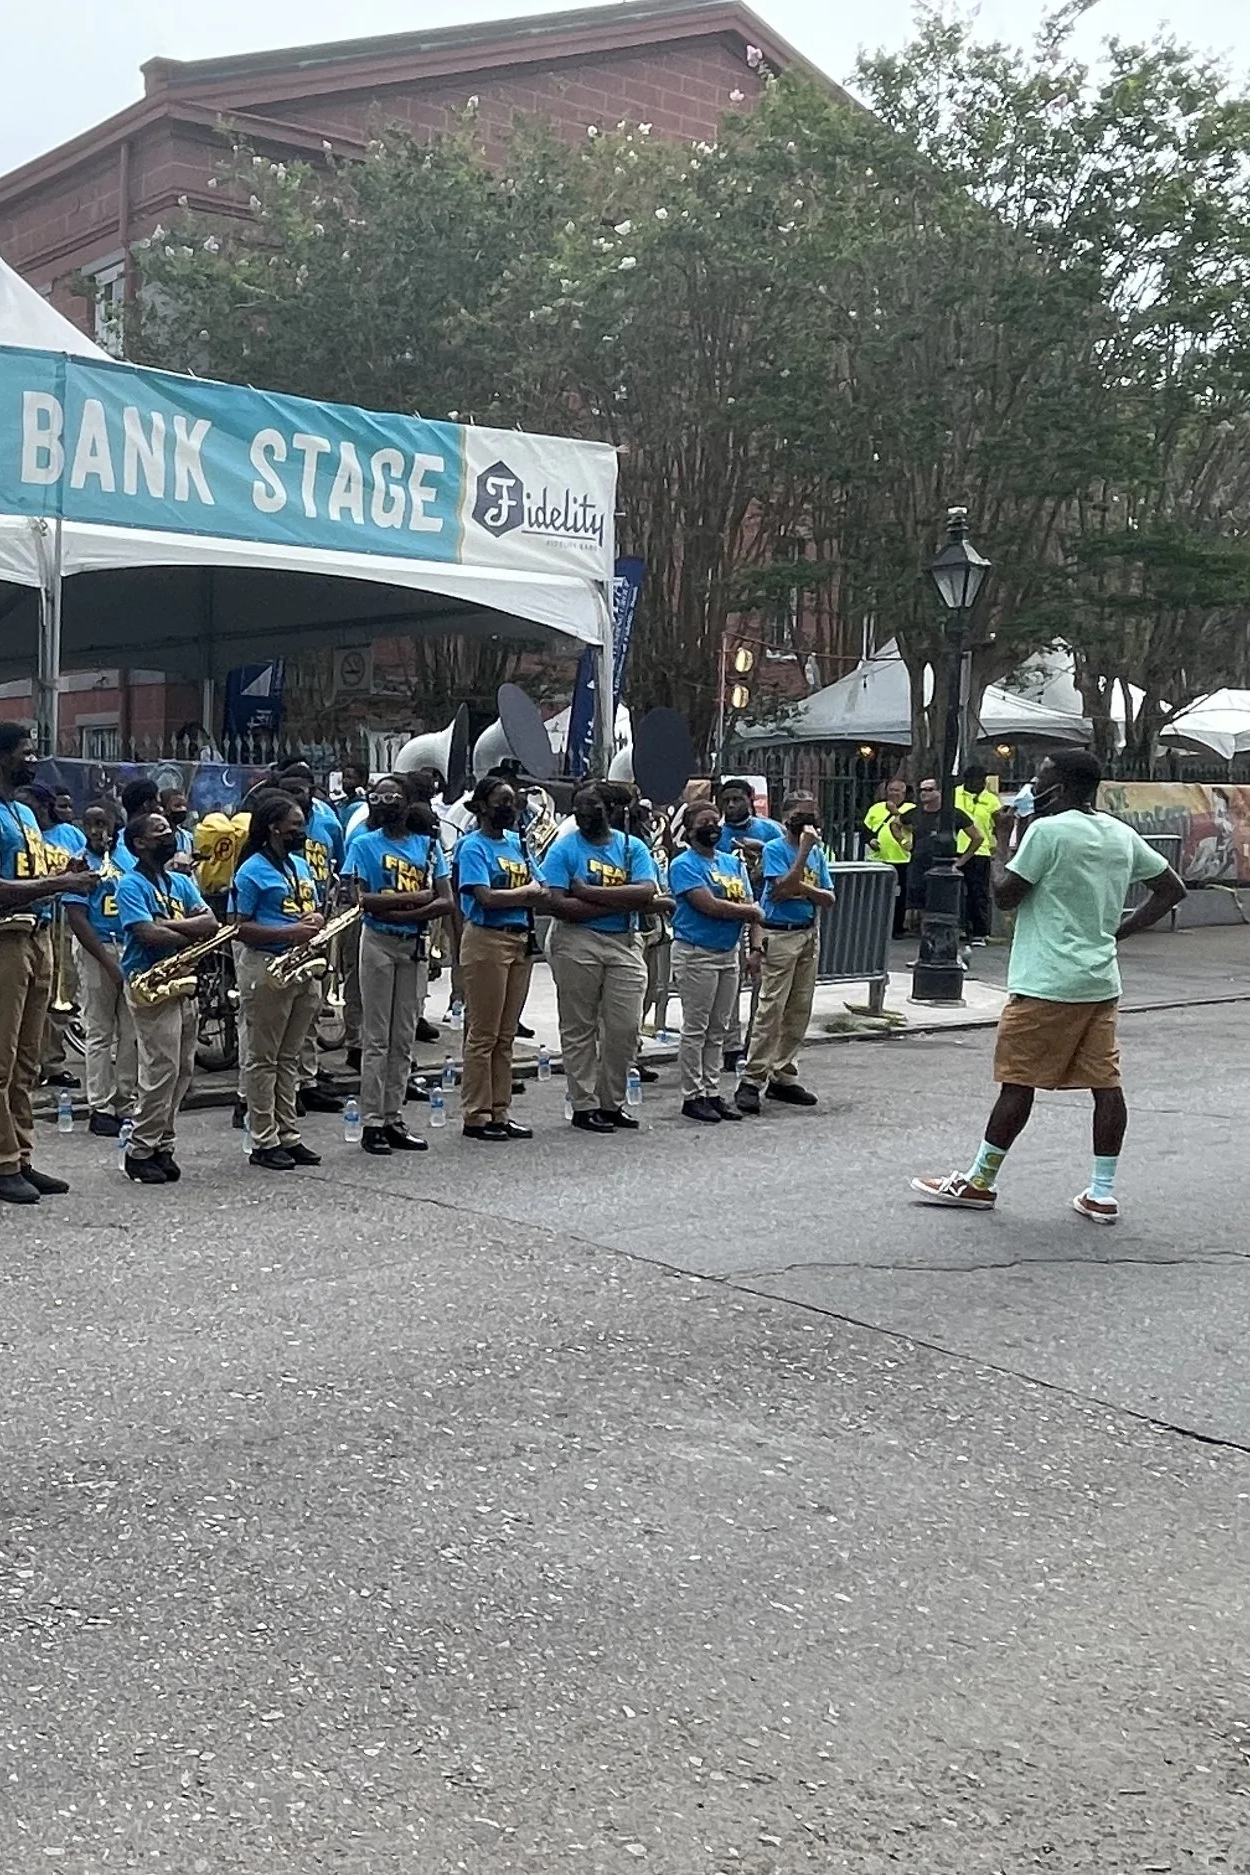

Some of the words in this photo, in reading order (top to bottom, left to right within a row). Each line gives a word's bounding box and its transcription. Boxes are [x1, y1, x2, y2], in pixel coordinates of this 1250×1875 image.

[21, 390, 215, 505] BANK
[250, 428, 445, 533] STAGE
[484, 476, 605, 547] Fidelity
